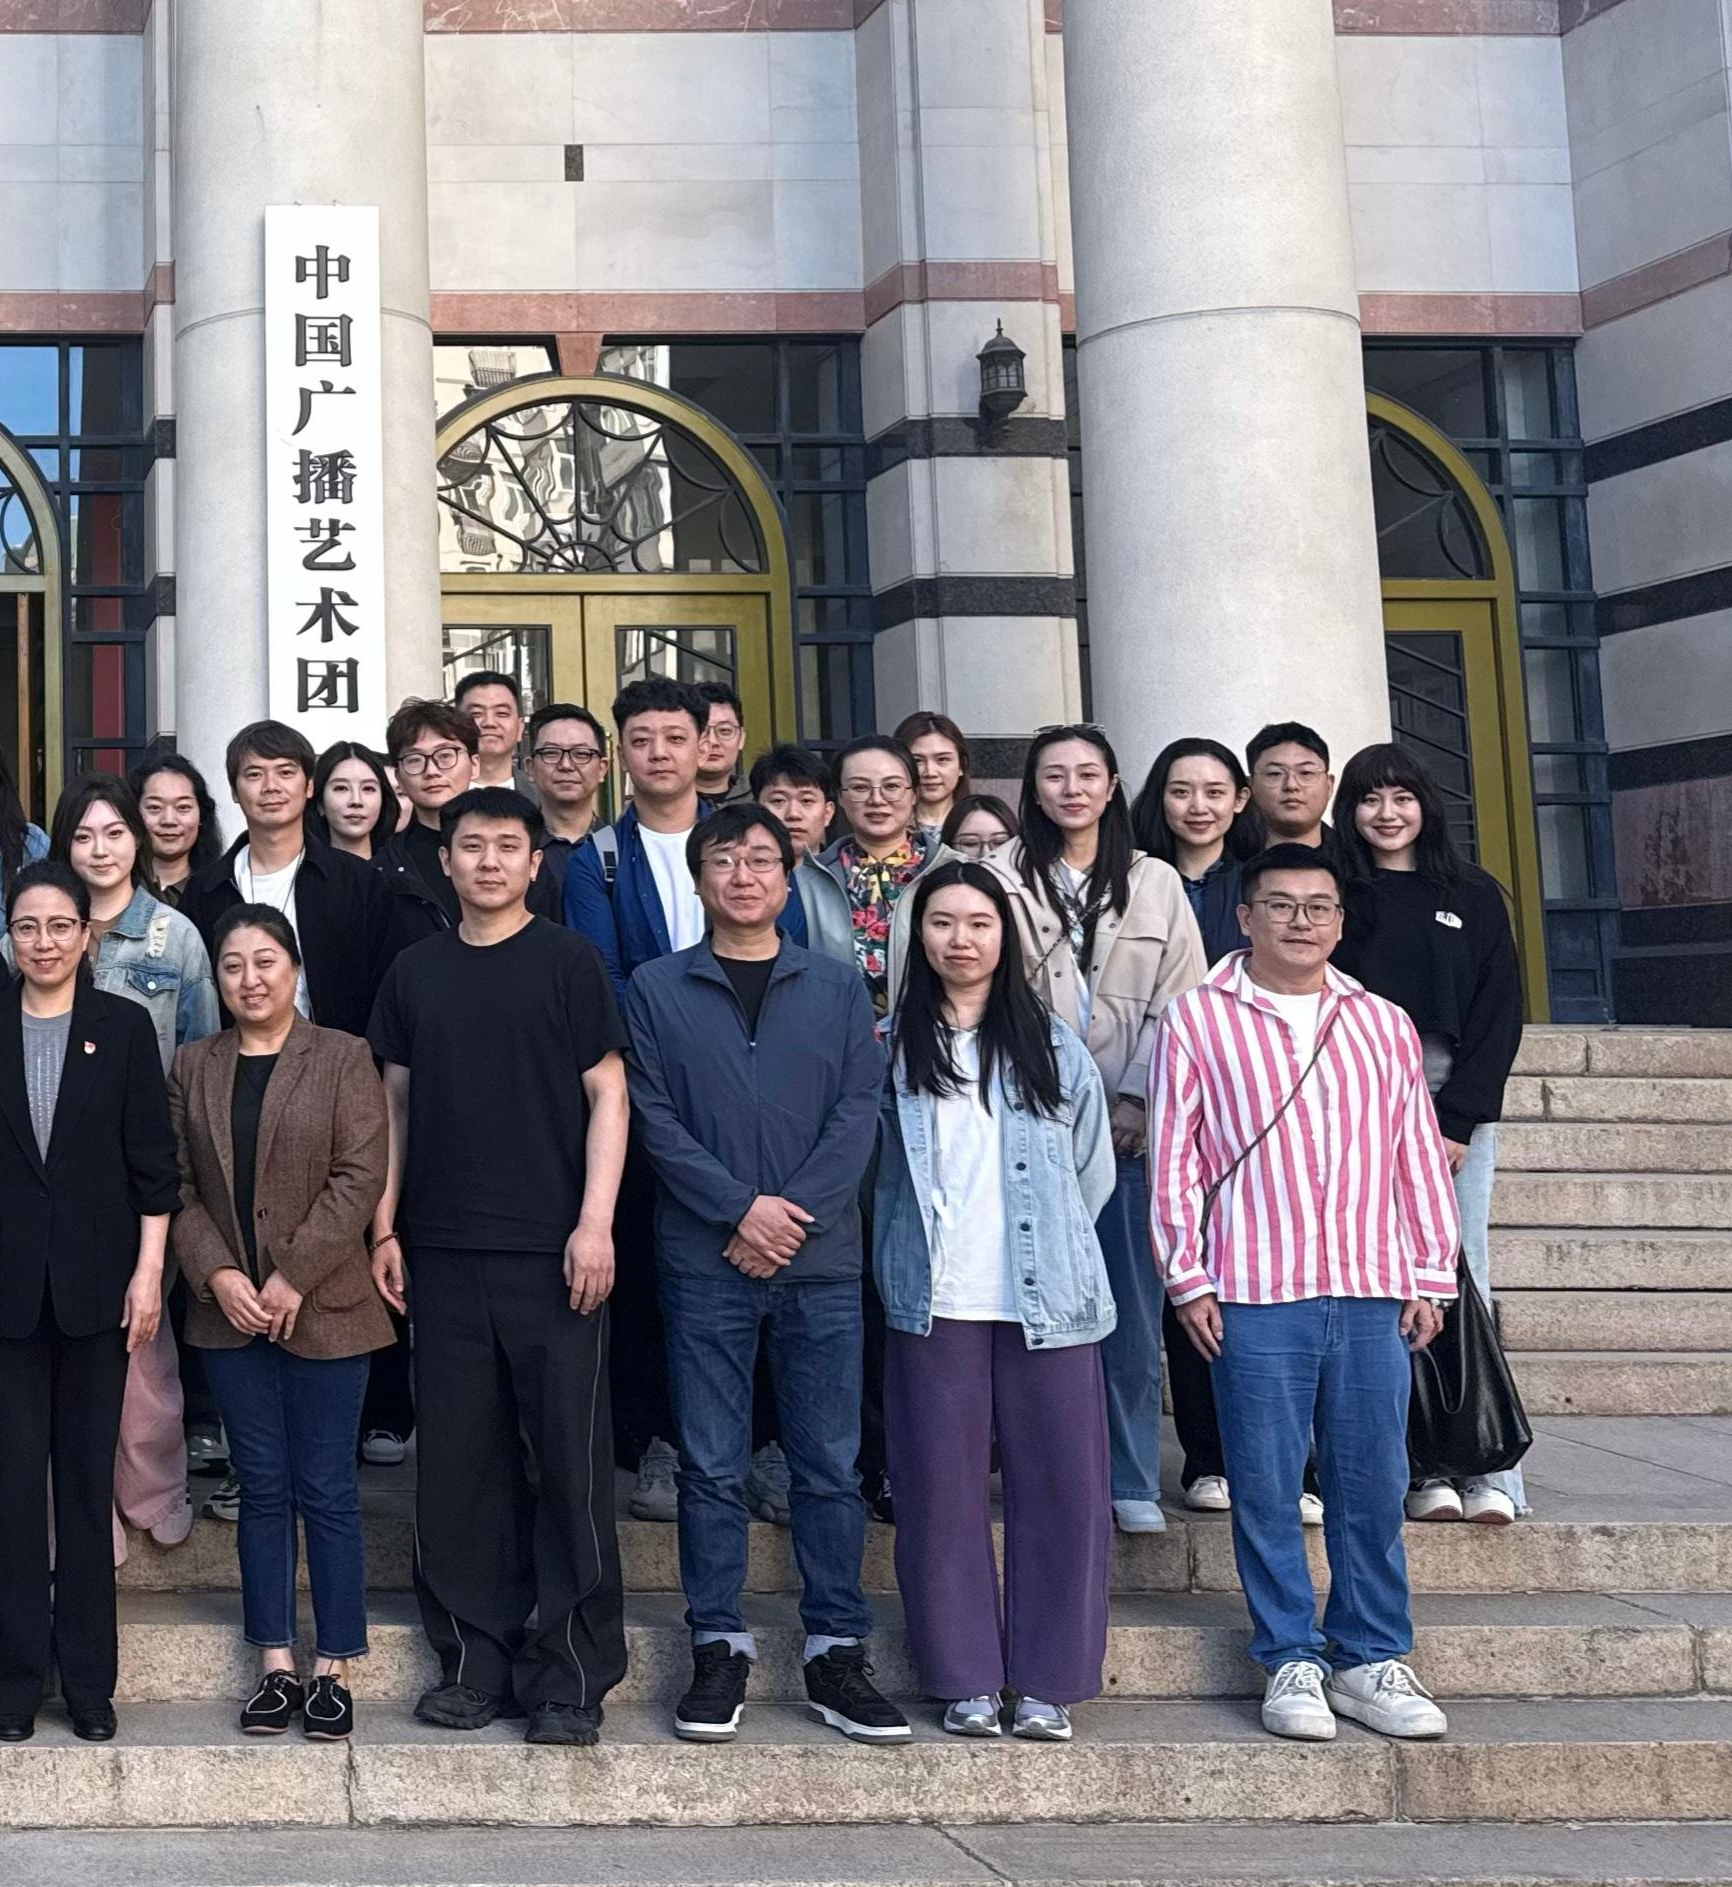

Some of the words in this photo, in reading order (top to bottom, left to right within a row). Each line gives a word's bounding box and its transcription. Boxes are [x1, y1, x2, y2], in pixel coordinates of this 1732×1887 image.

[291, 244, 360, 713] 中国广播艺术团
